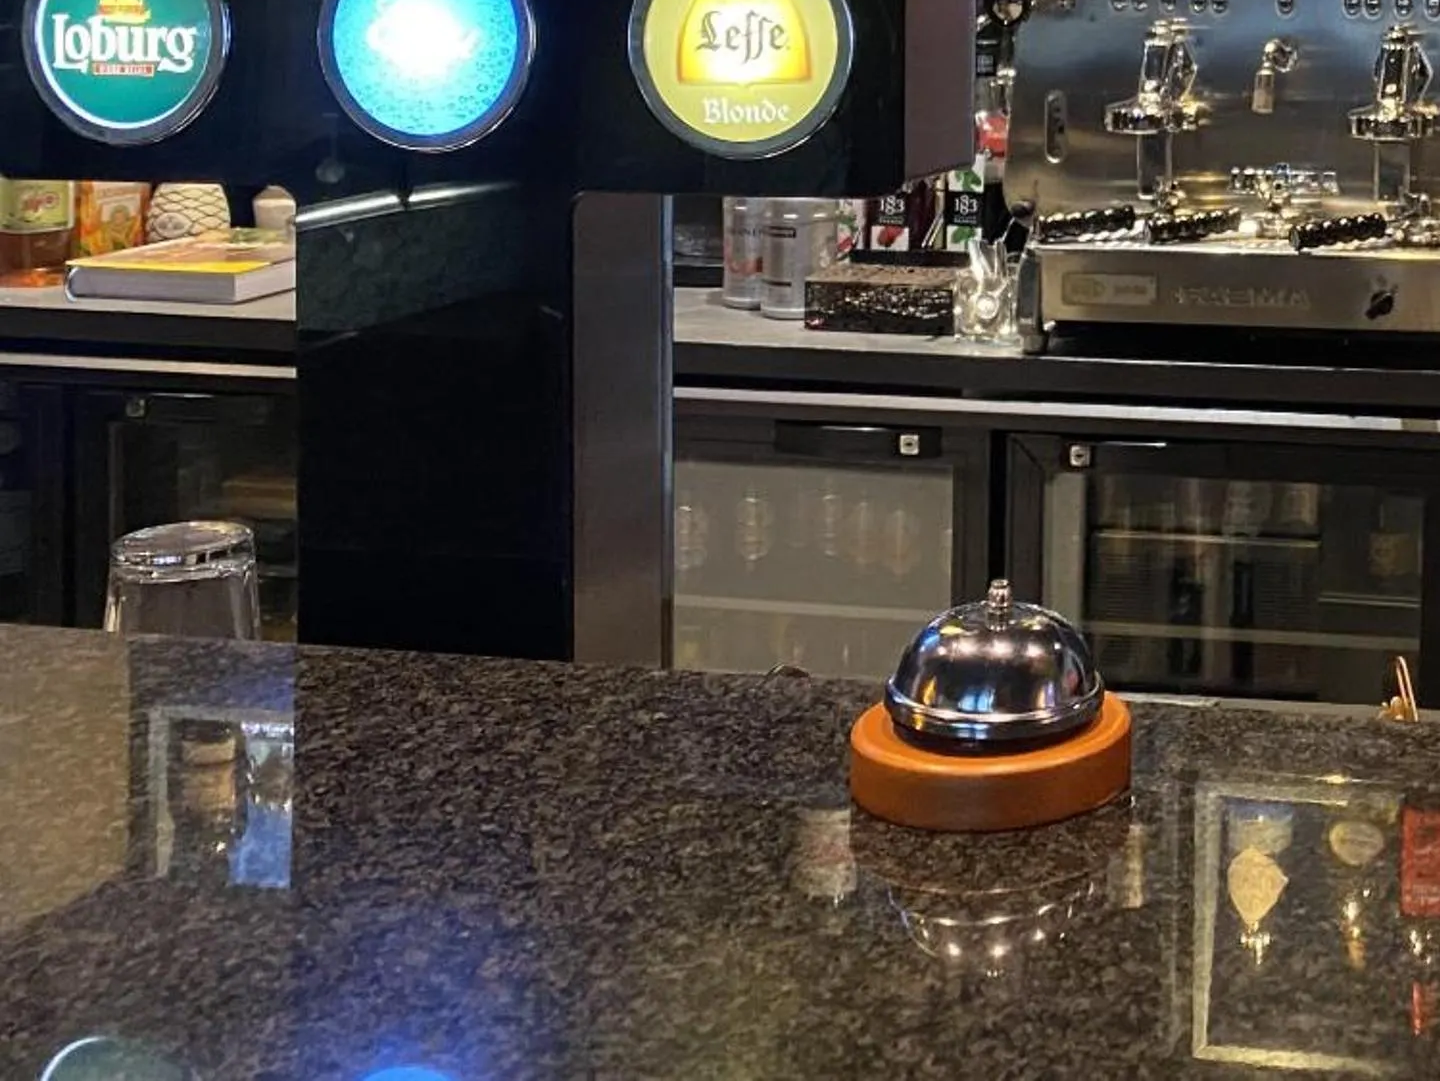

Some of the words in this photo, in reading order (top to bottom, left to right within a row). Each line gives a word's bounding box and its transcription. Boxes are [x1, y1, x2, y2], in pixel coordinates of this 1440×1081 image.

[52, 13, 200, 73] Loburg
[695, 10, 790, 65] Leffe
[703, 97, 790, 124] Blonde
